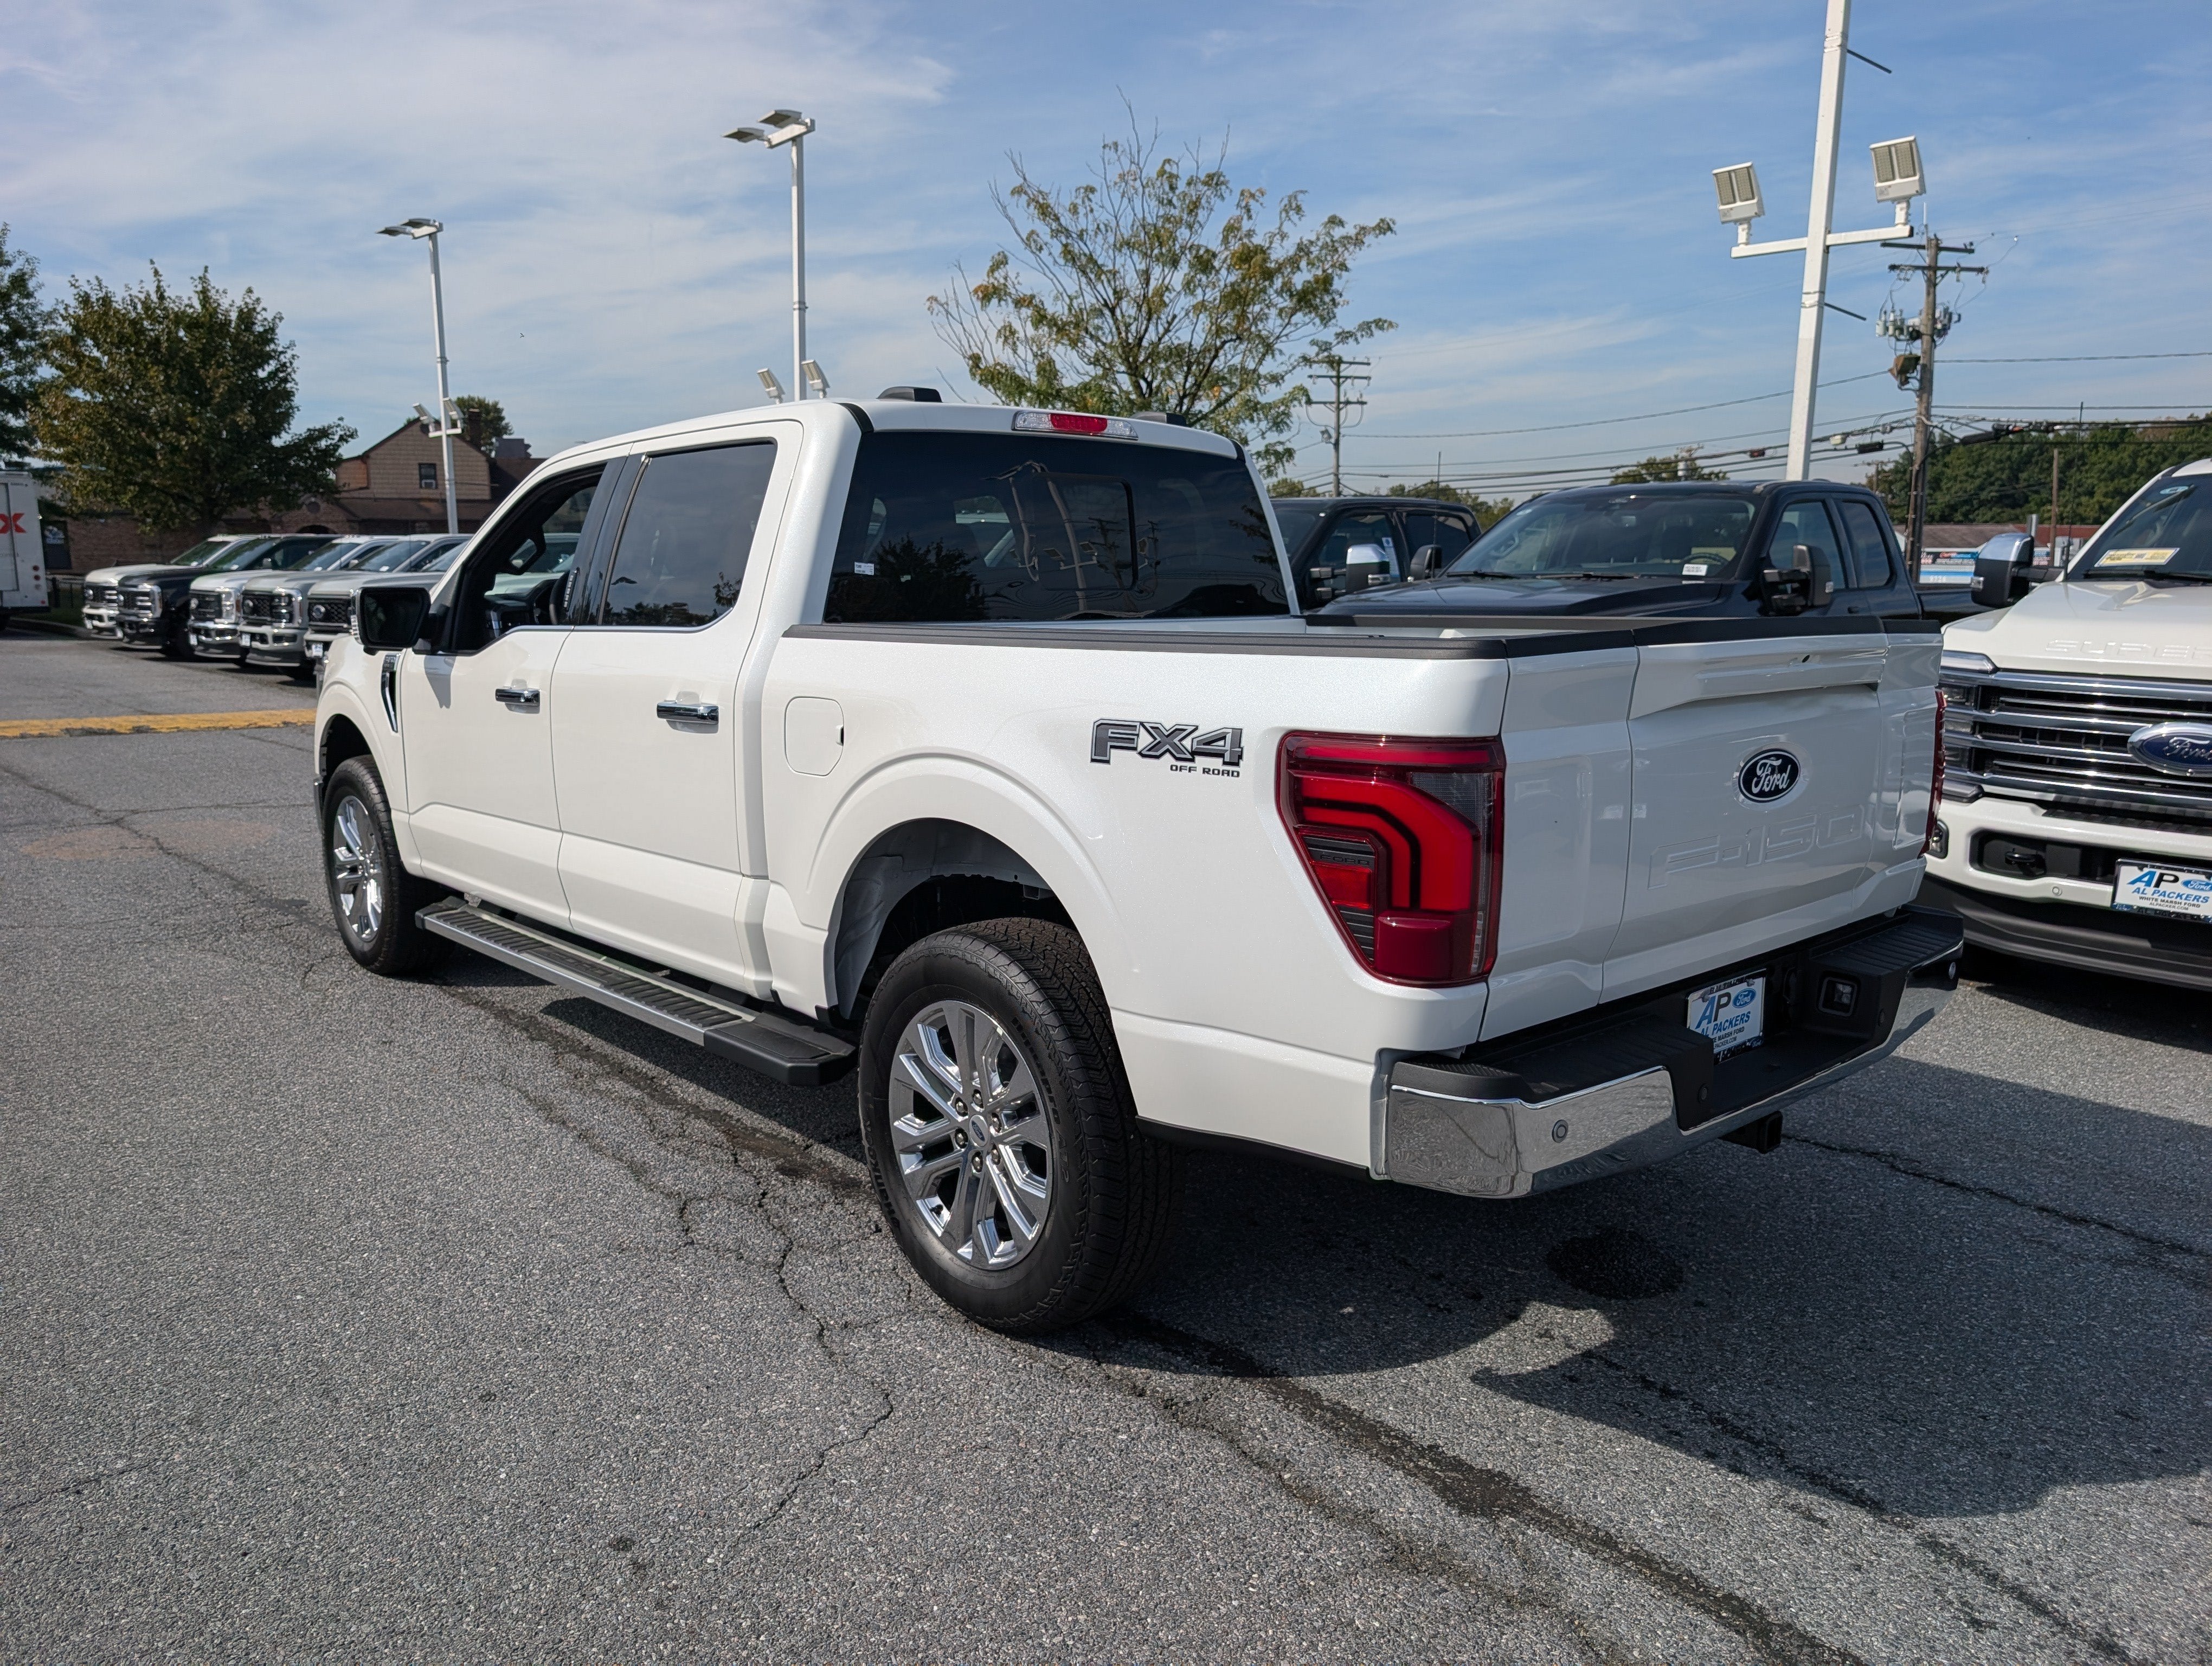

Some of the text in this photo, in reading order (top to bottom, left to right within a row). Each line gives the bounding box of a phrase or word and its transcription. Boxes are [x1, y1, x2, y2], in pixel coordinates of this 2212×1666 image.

[1090, 718, 1244, 767] FX4
[1170, 765, 1240, 778] OFF ROAD
[1751, 759, 1791, 793] Ford
[1647, 804, 1865, 890] F-150
[1320, 854, 1369, 866] FORD
[2127, 870, 2179, 888] AP
[2132, 887, 2210, 904] AL PACKERS
[1695, 992, 1732, 1030] AP
[1712, 1011, 1751, 1036] PACKERS
[1714, 1036, 1737, 1048] PACKER.COM
[1718, 1030, 1733, 1041] MARSH
[1733, 1026, 1745, 1036] FORD
